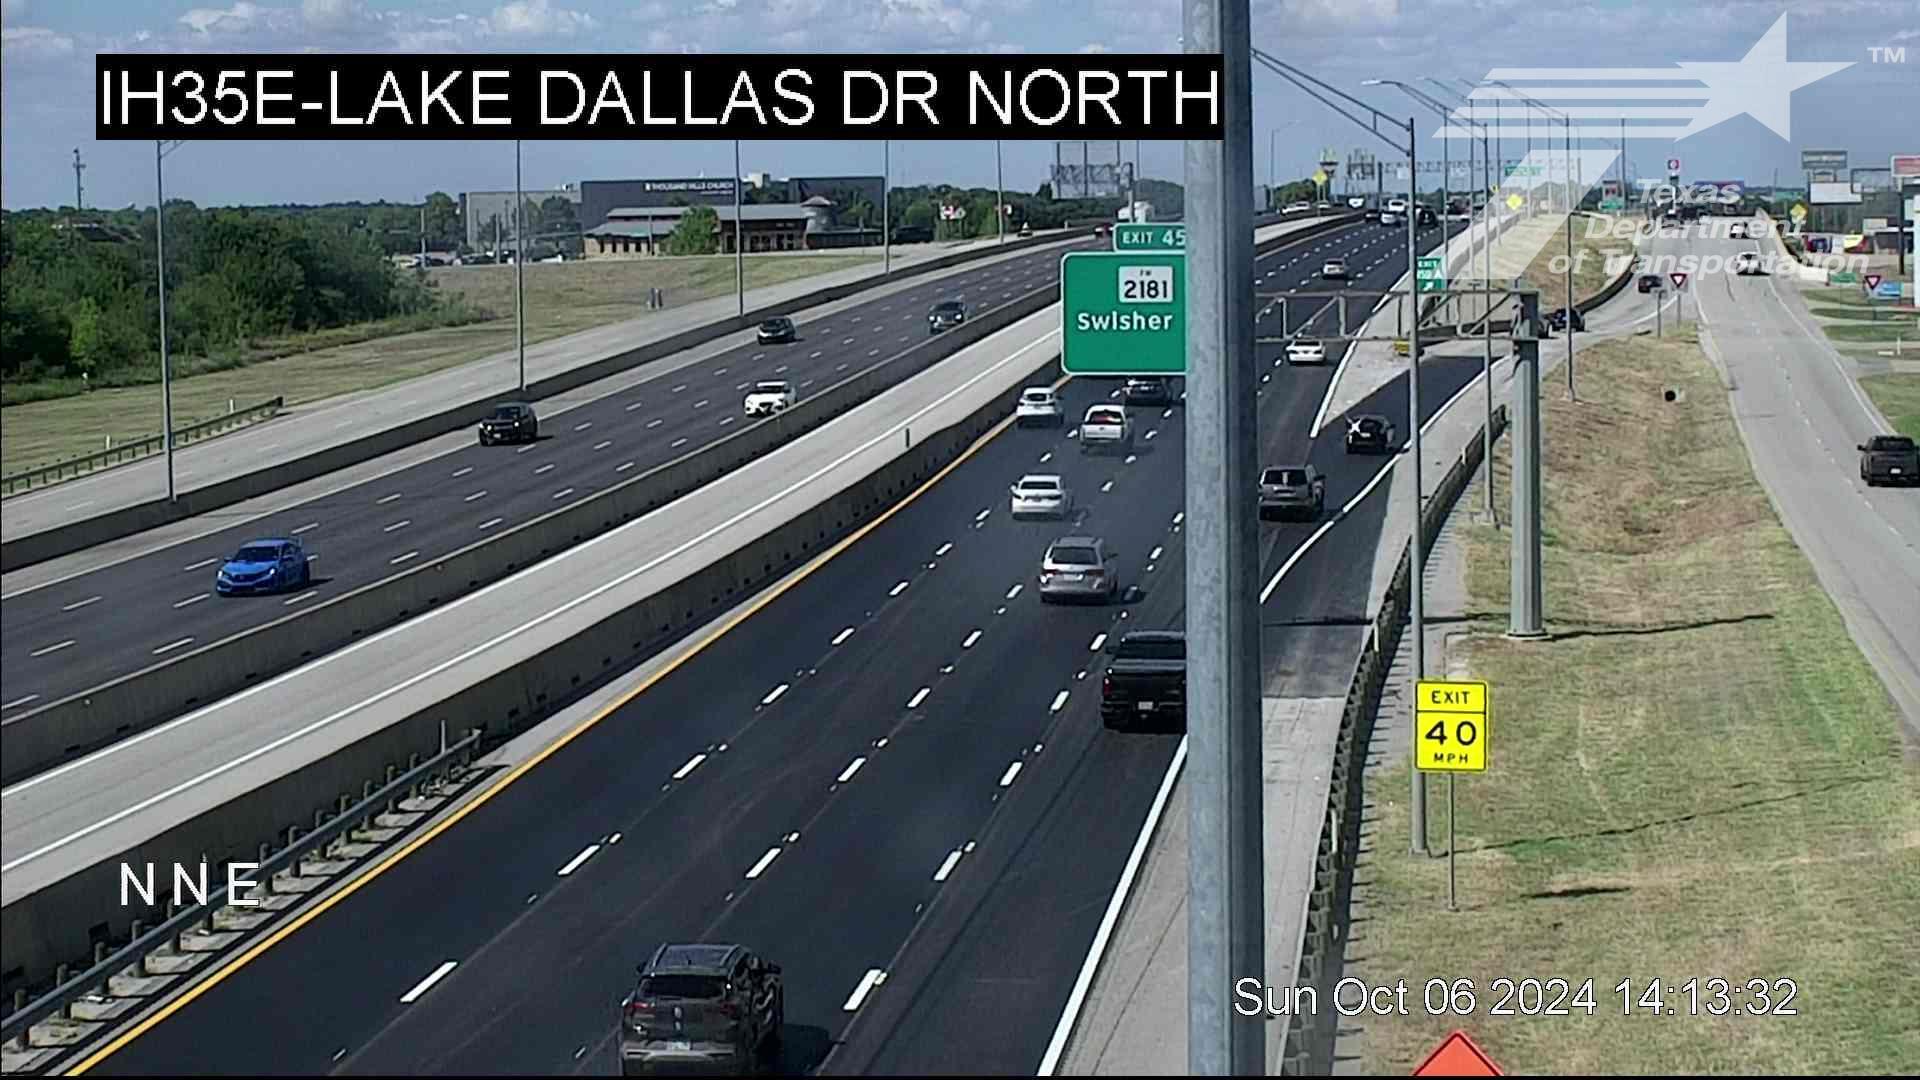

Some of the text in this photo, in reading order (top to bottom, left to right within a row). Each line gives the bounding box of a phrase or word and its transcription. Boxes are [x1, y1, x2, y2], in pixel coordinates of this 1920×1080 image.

[1122, 231, 1153, 245] EXIT
[1124, 280, 1168, 299] 2181
[1077, 310, 1173, 331] Swisher
[1431, 690, 1471, 705] EXIT
[1425, 720, 1477, 746] 40
[1433, 752, 1469, 764] MPH
